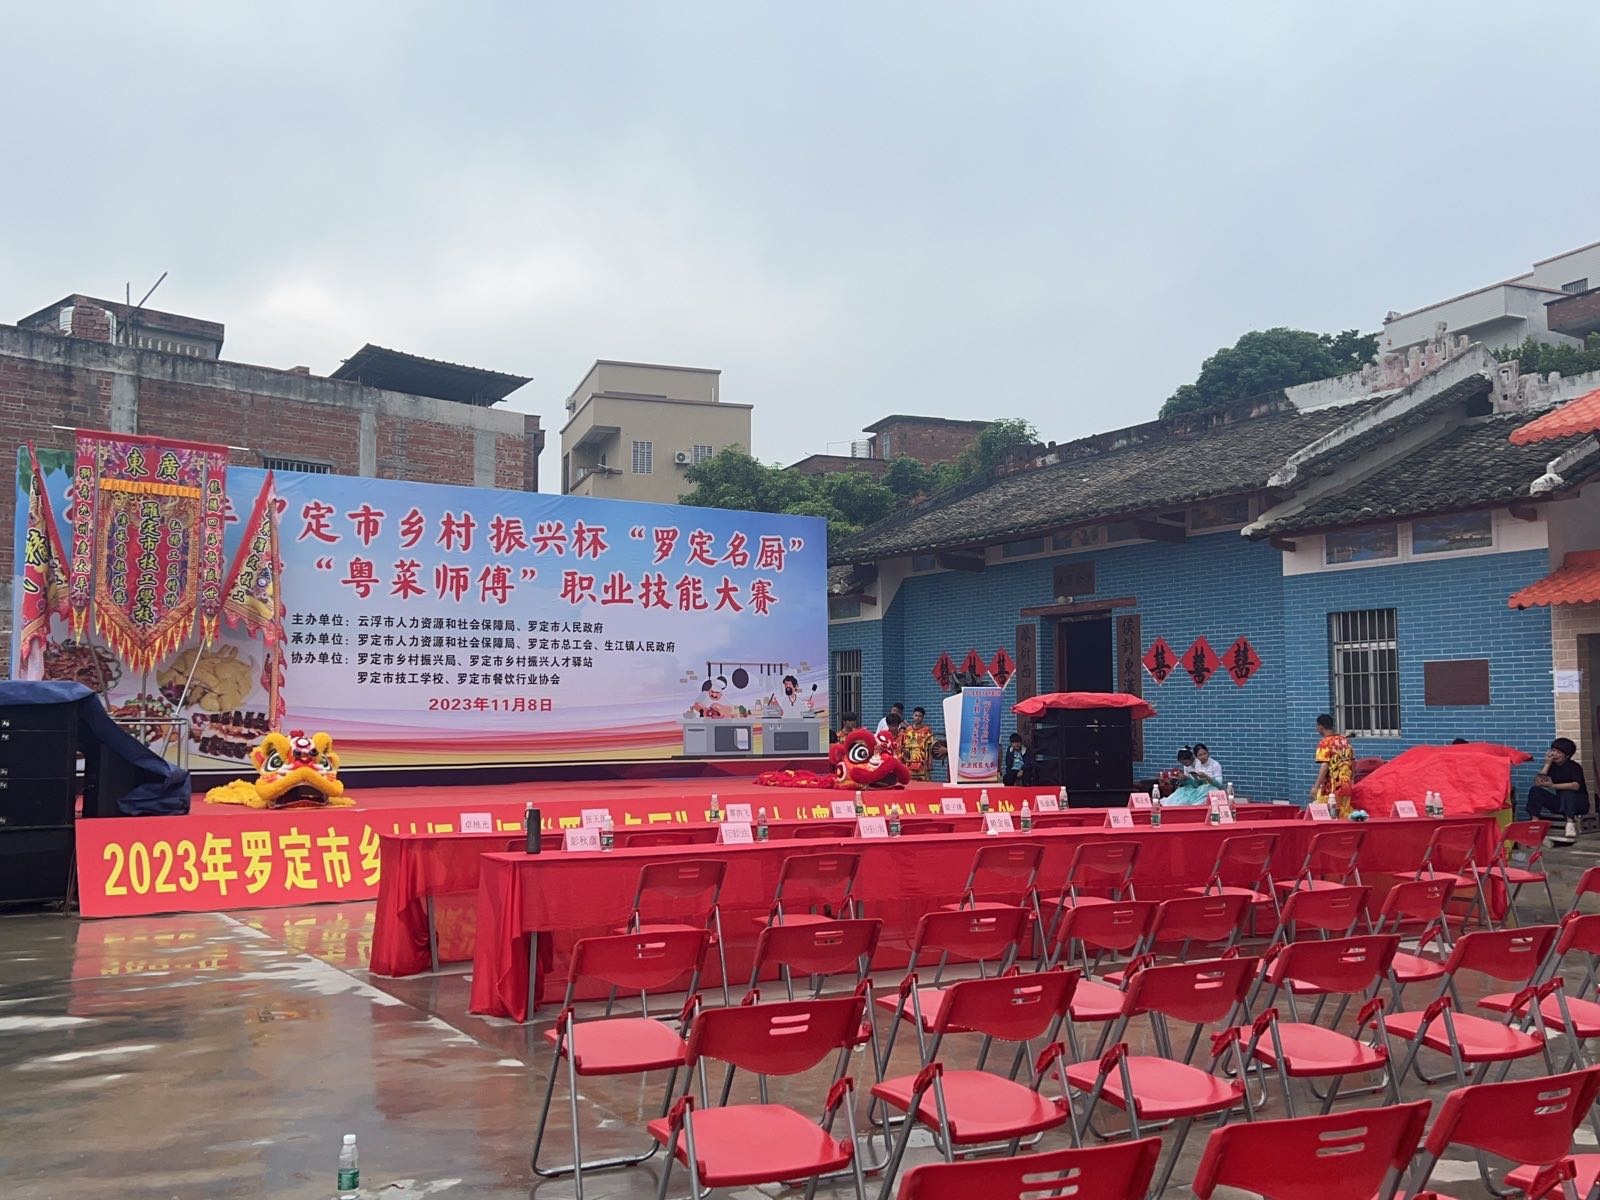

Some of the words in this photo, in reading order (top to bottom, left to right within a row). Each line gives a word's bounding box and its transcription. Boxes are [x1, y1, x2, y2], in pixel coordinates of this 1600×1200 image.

[277, 500, 804, 574] 定市乡村振兴杯“罗定名厨”
[357, 671, 561, 686] 罗定市技工学校、罗定市餐饮行业协会
[429, 697, 552, 712] 2023年11月8日
